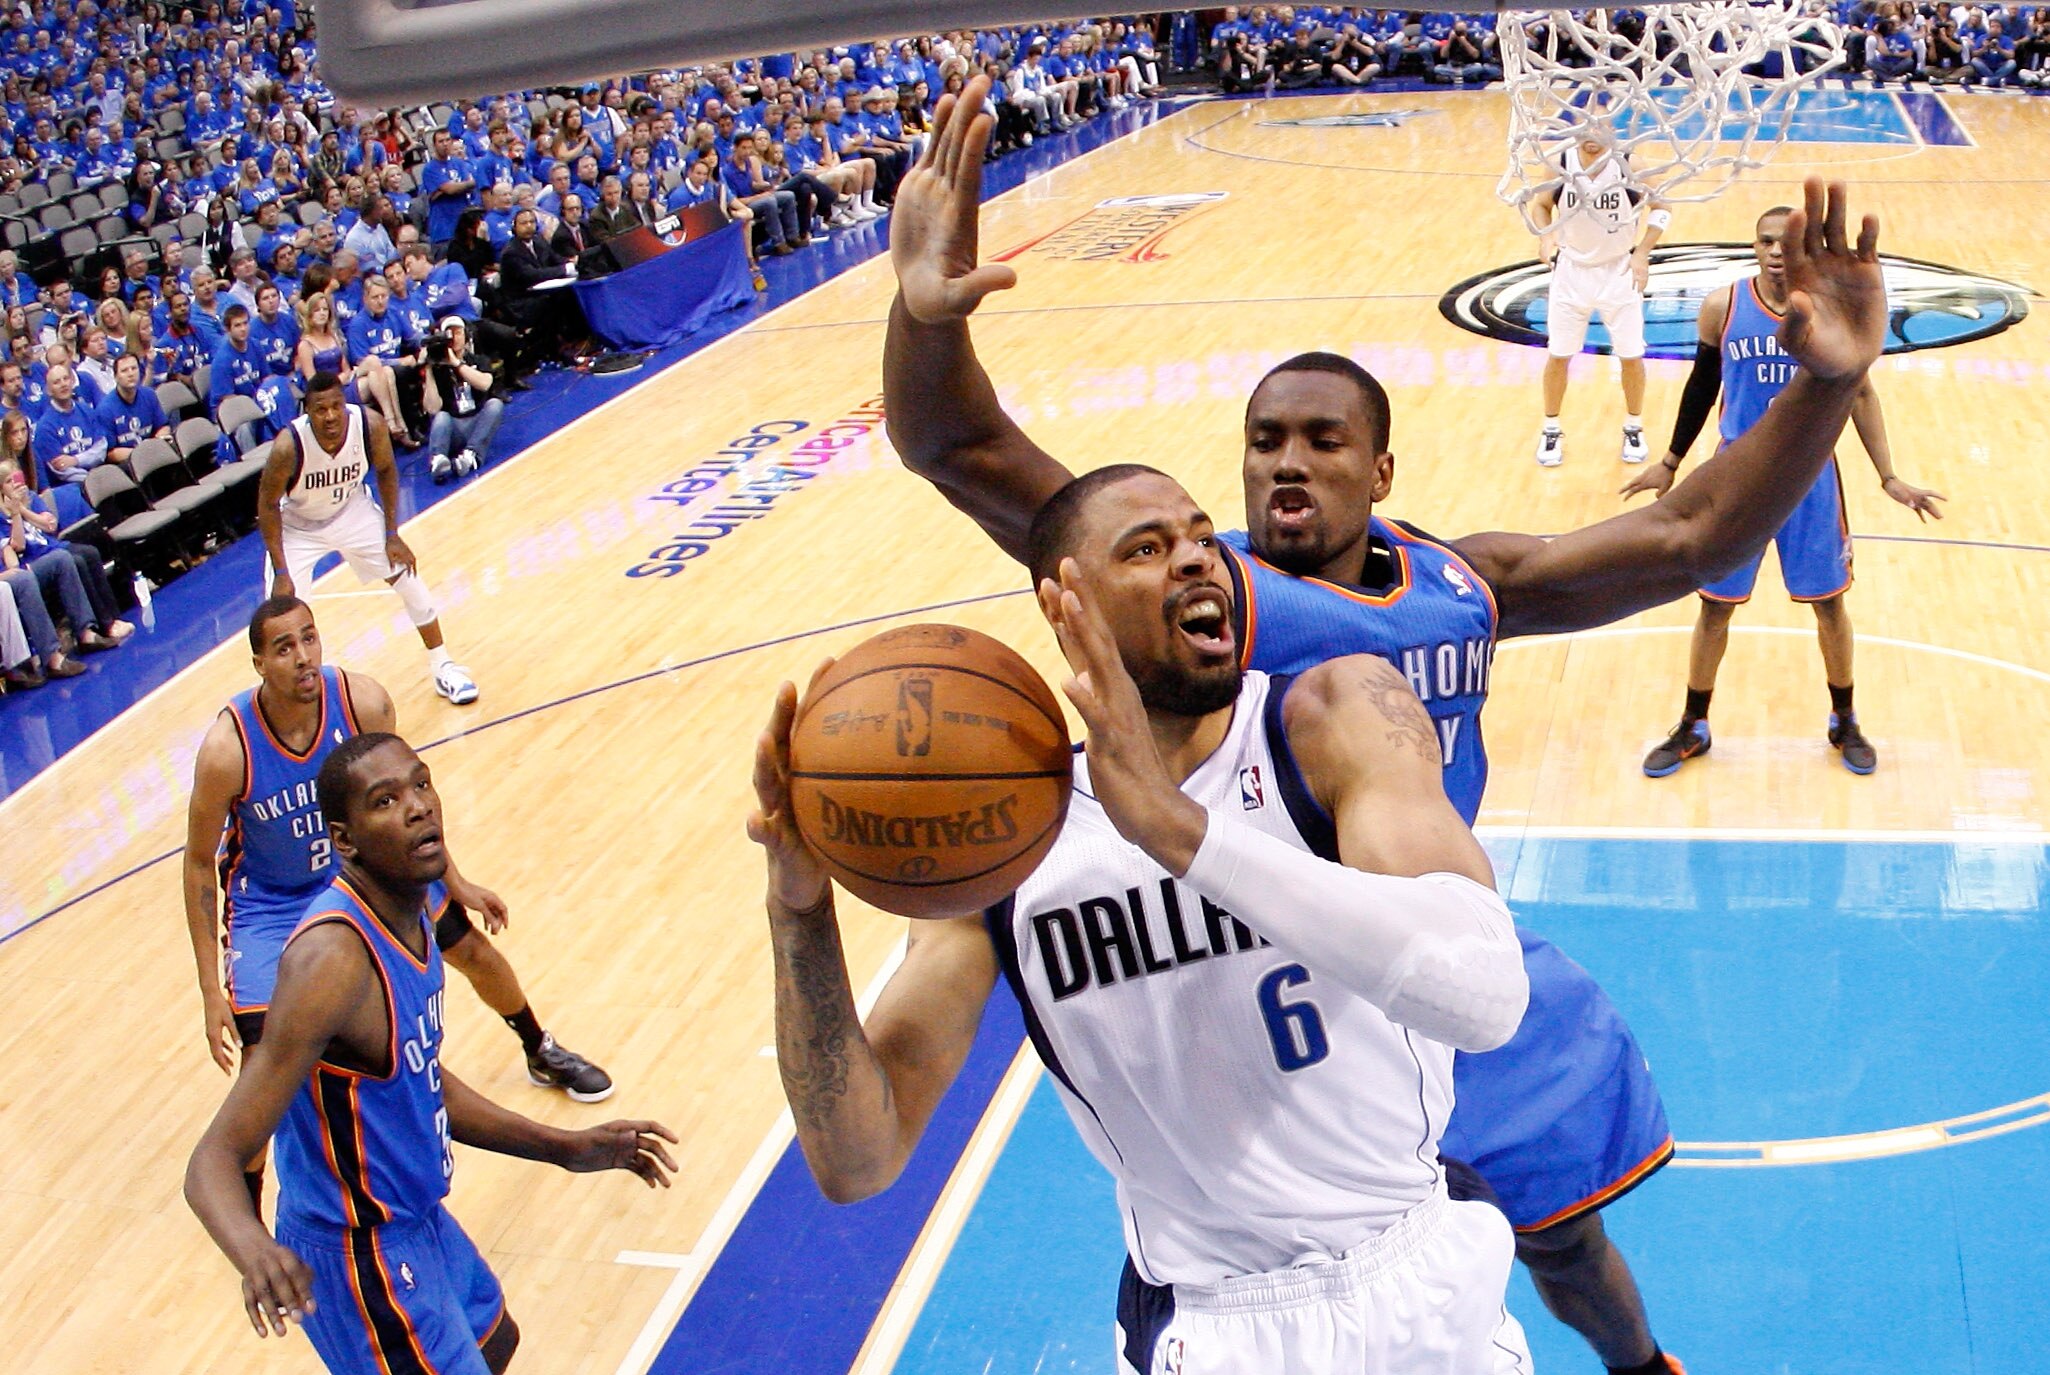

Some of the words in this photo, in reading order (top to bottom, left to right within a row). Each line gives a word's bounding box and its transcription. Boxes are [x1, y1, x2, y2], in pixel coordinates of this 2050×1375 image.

[1567, 192, 1620, 210] DLAS
[1071, 203, 1202, 261] WESTERN
[1757, 363, 1799, 383] CITY
[305, 462, 360, 490] DALLAS
[648, 419, 810, 506] Center
[815, 789, 1019, 849] SPALDING
[310, 837, 332, 872] 2
[1030, 876, 1273, 1002] DALLA
[1252, 960, 1331, 1073] 6
